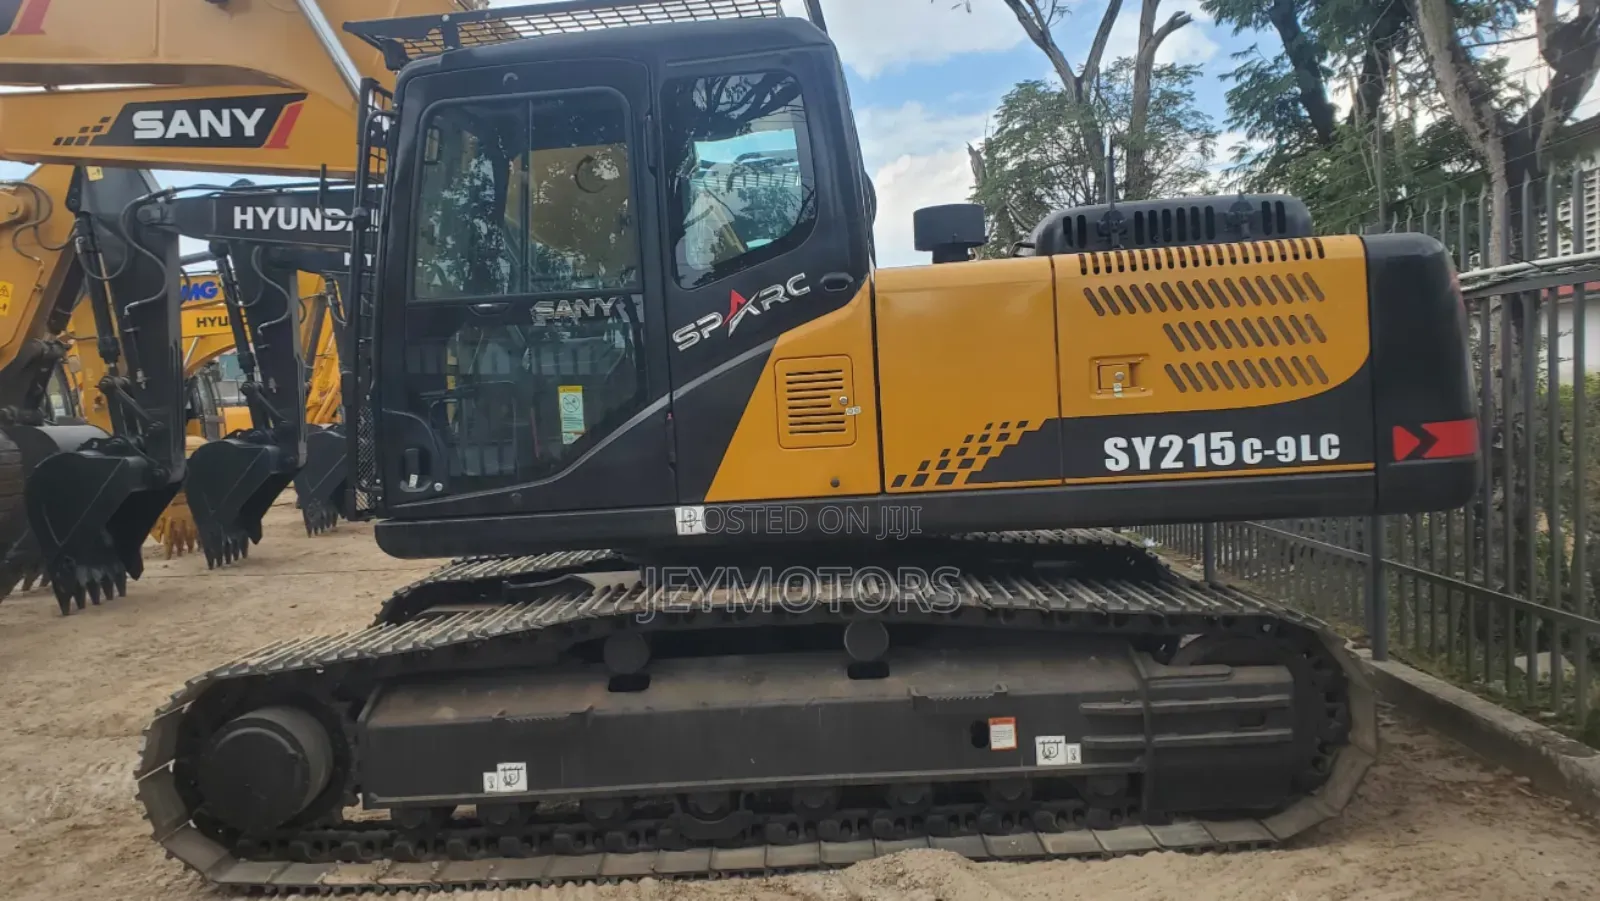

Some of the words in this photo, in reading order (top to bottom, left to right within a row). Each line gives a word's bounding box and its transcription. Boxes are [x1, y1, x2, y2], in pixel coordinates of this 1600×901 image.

[132, 108, 266, 139] SANY
[233, 206, 380, 232] HYUNDI
[530, 297, 618, 328] SANY
[672, 272, 811, 352] SPARC
